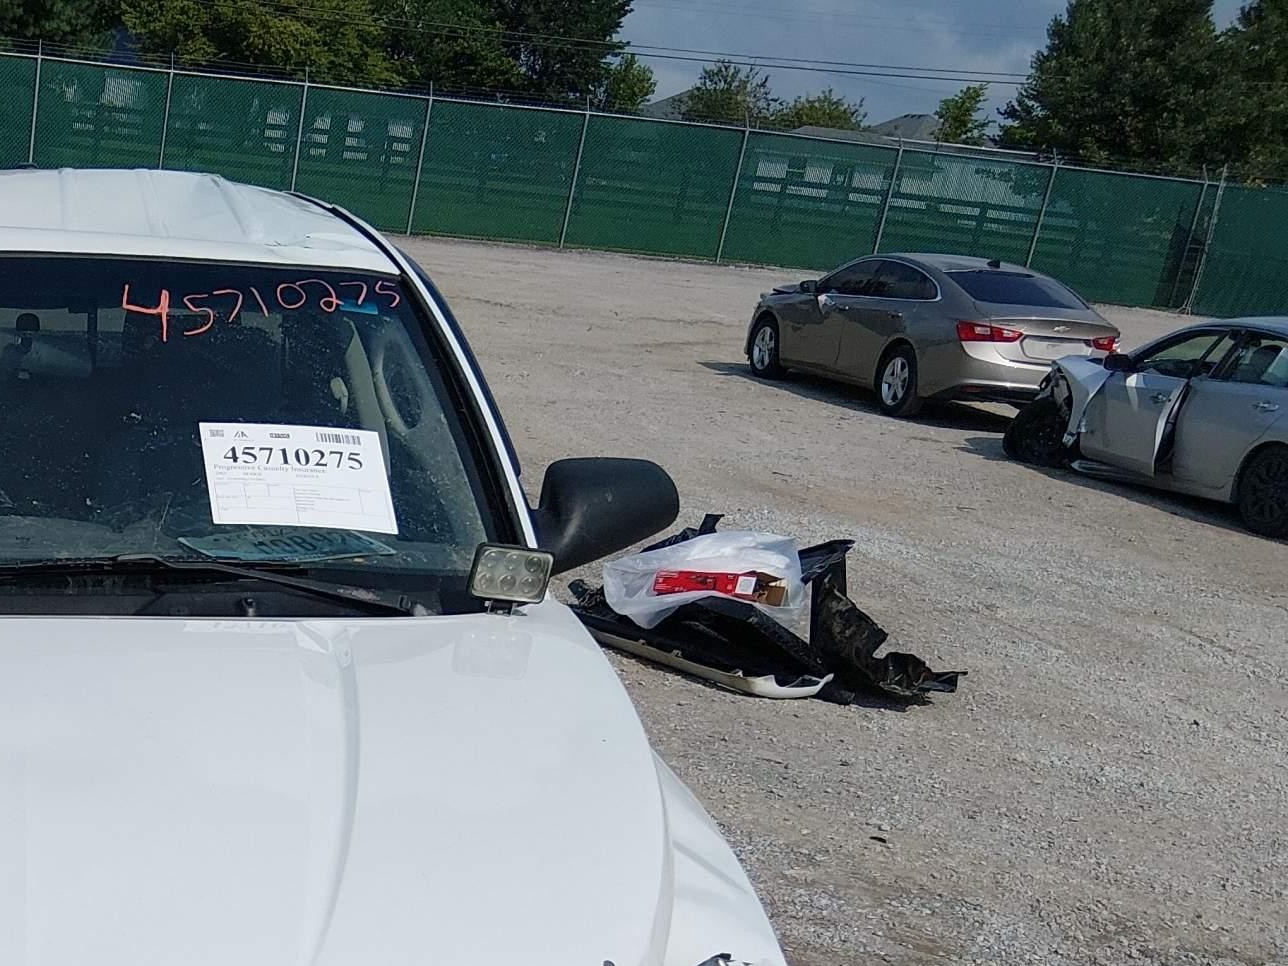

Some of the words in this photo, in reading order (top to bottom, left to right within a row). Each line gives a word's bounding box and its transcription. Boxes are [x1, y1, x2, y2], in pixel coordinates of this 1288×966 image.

[122, 279, 401, 342] 45710275
[213, 463, 256, 472] Progressive
[292, 465, 326, 474] Insurance
[223, 446, 363, 470] 45710275
